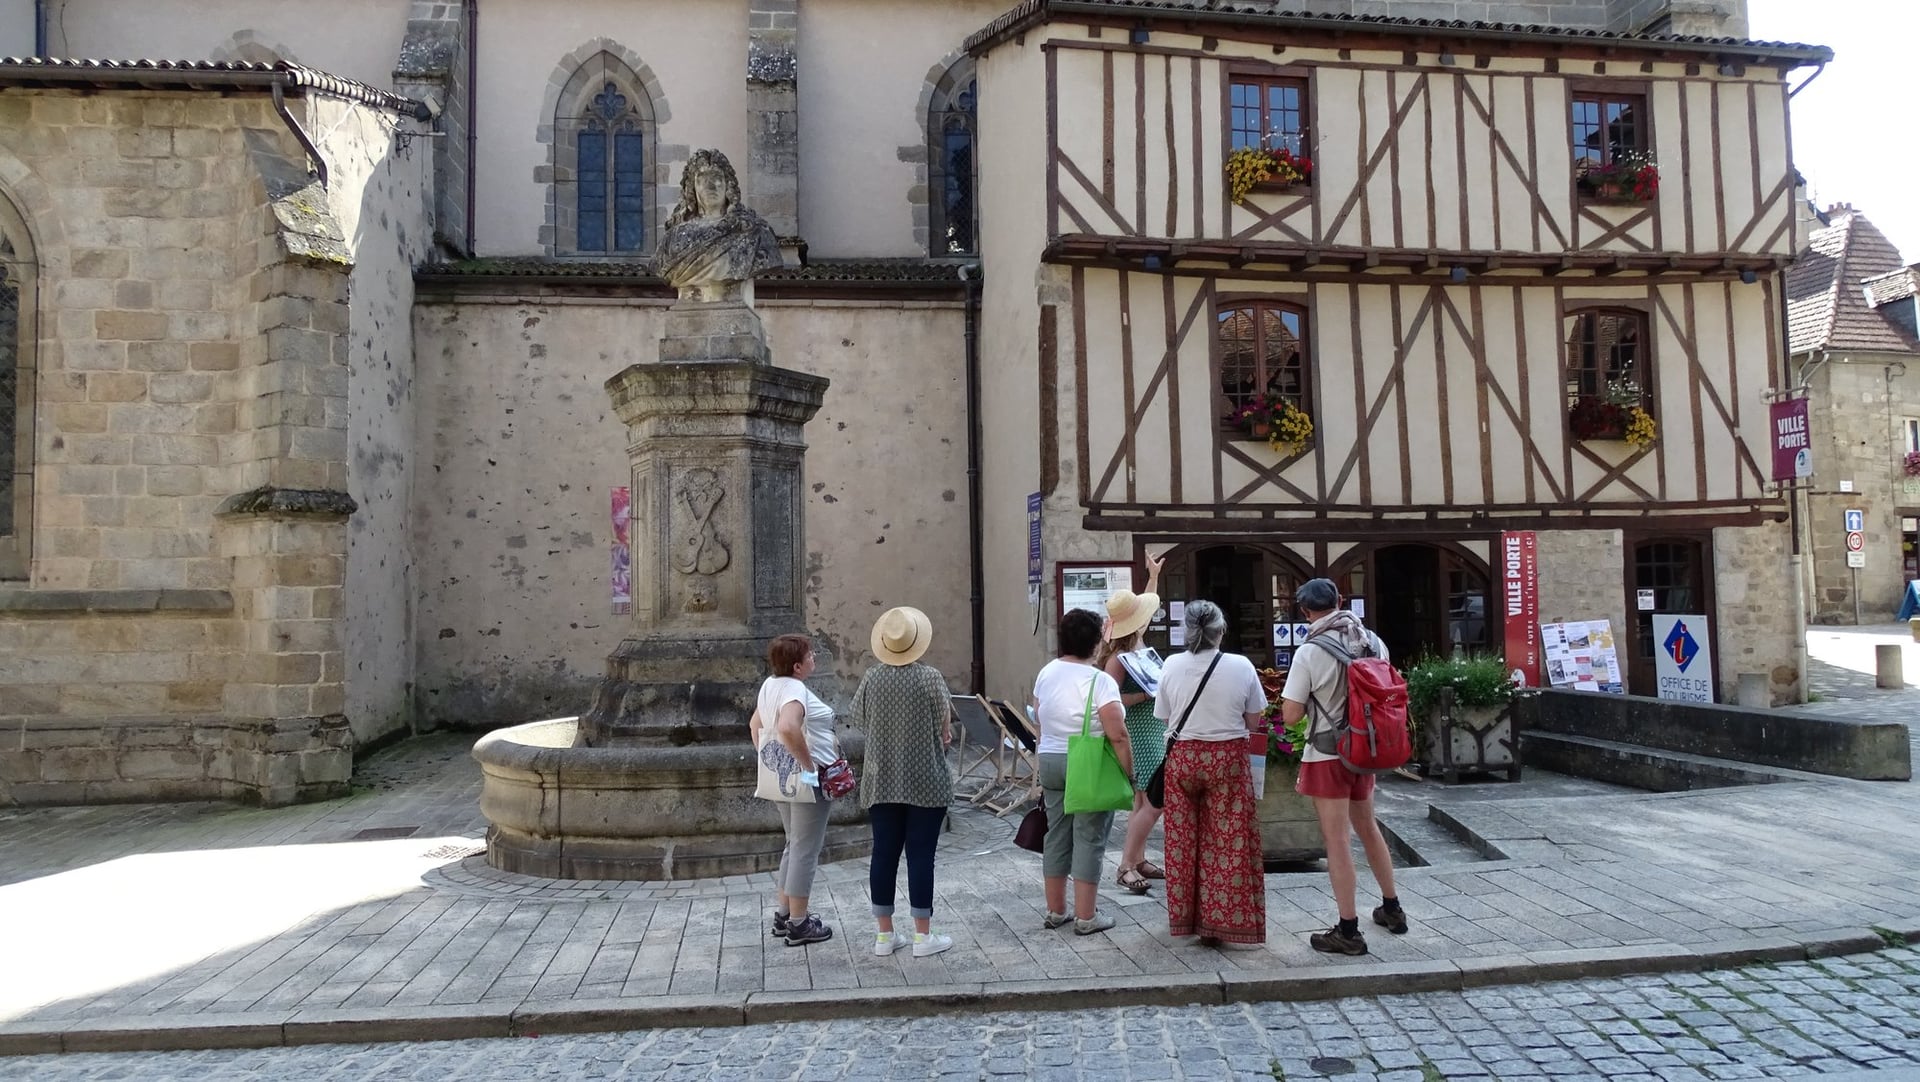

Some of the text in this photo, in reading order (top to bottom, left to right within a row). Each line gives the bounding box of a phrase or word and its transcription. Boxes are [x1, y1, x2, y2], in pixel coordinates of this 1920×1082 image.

[1777, 415, 1805, 434] VILLE
[1778, 432, 1807, 450] PORTE
[1852, 537, 1860, 546] 10
[1506, 537, 1522, 616] VILLE PORTE
[1525, 554, 1534, 599] S'INVENTE
[1660, 677, 1708, 692] OFFICE DE
[1663, 690, 1707, 703] TOURISME
